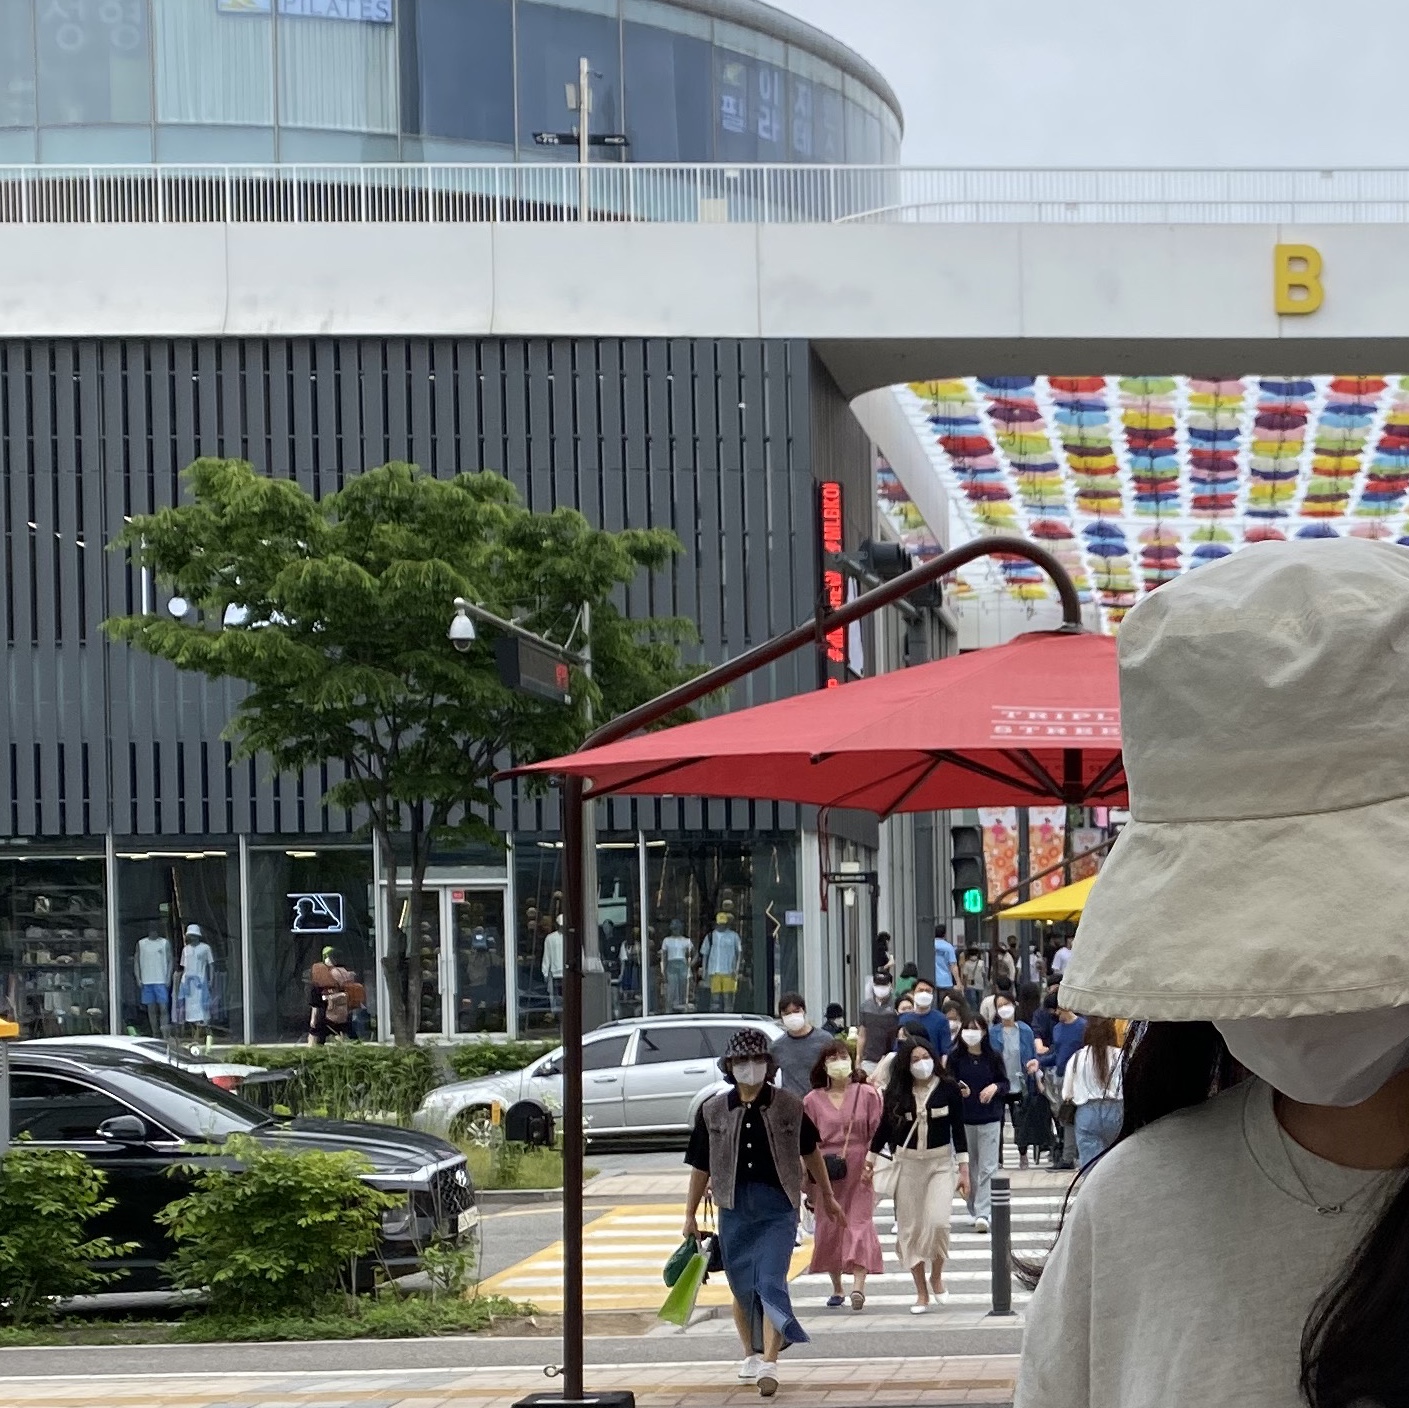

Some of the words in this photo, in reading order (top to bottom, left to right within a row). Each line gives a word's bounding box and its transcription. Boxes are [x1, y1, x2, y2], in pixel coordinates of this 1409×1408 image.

[1274, 244, 1324, 316] B
[1001, 711, 1115, 720] TRIPL
[993, 725, 1120, 736] STREE
